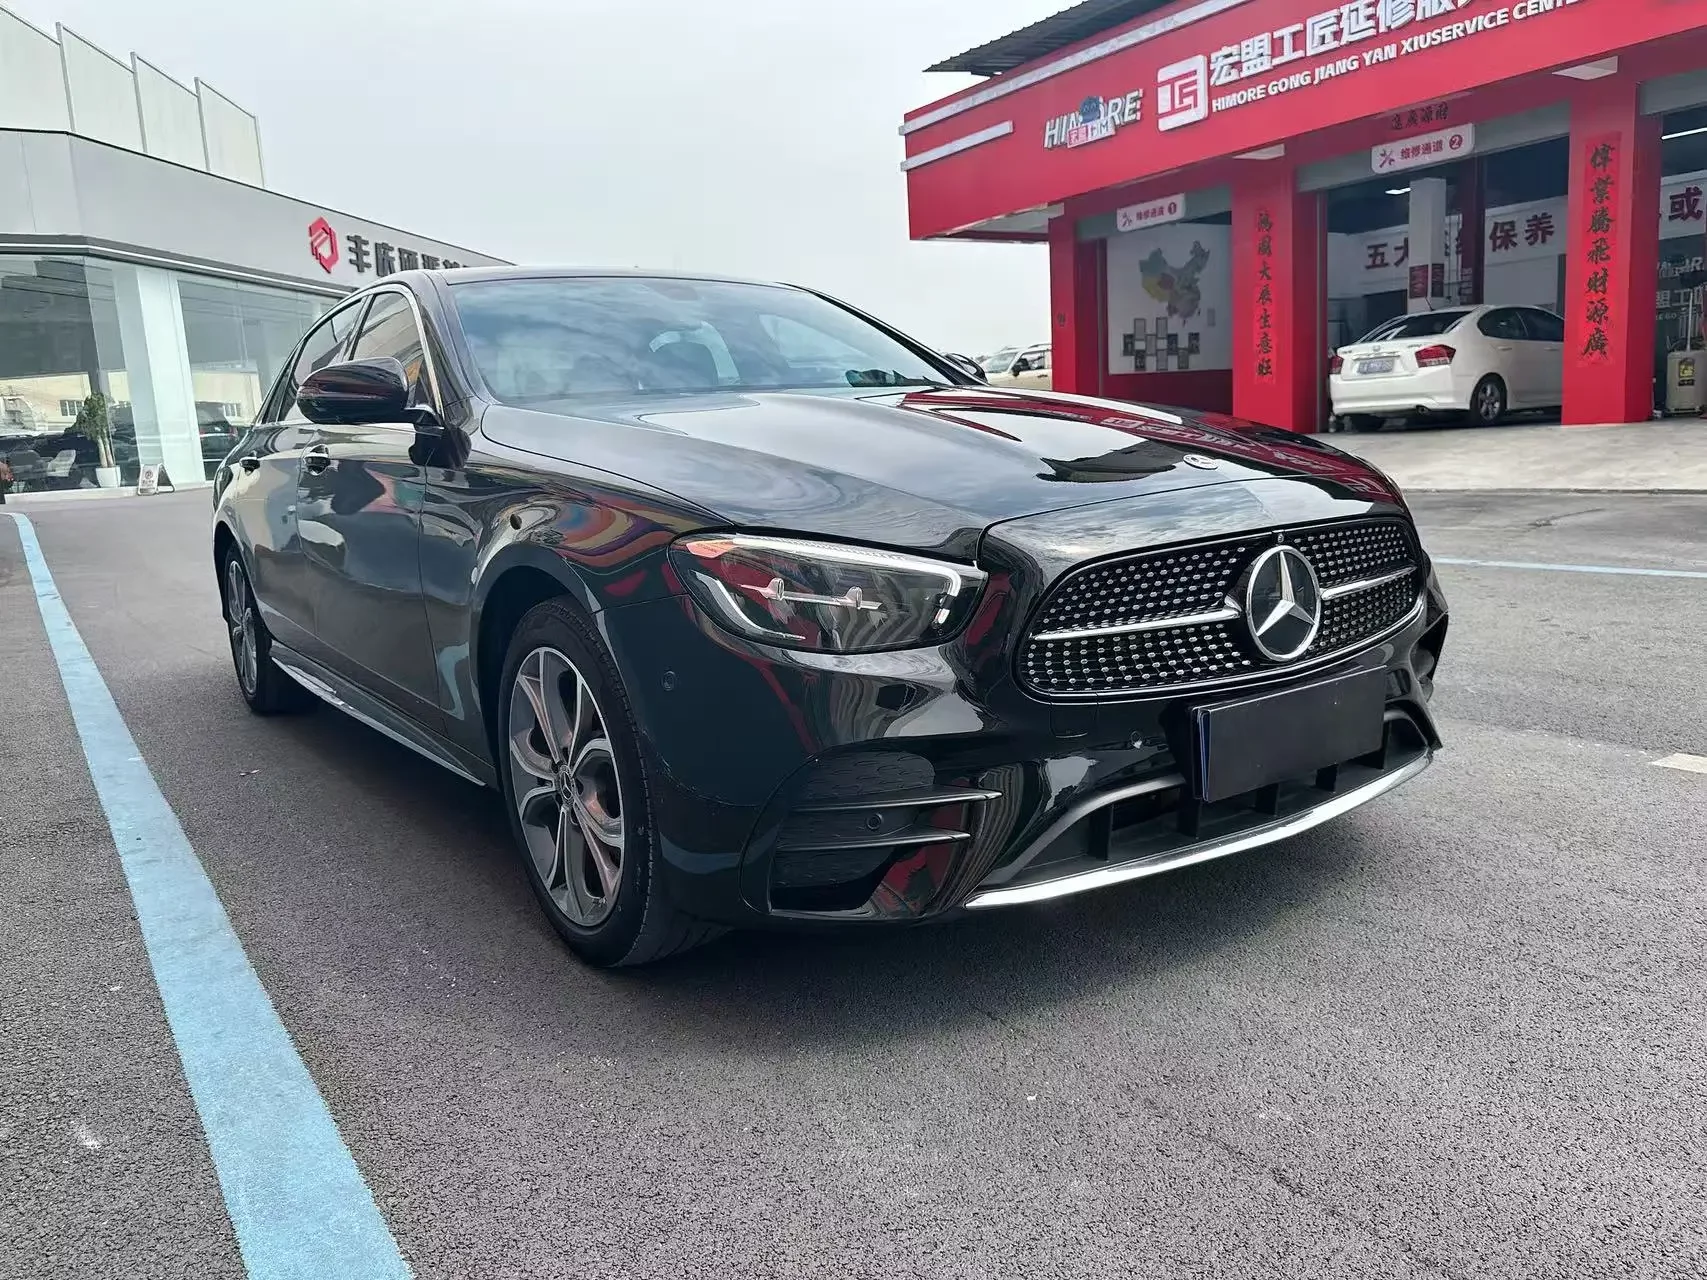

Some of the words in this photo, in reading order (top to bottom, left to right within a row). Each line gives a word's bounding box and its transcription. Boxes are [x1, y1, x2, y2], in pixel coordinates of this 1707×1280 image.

[1212, 84, 1266, 113] HIMORE
[1267, 70, 1312, 96] GONG
[1313, 57, 1360, 85] JIANG
[1362, 43, 1398, 66] YAN
[1400, 8, 1510, 56] XIUSERVICE
